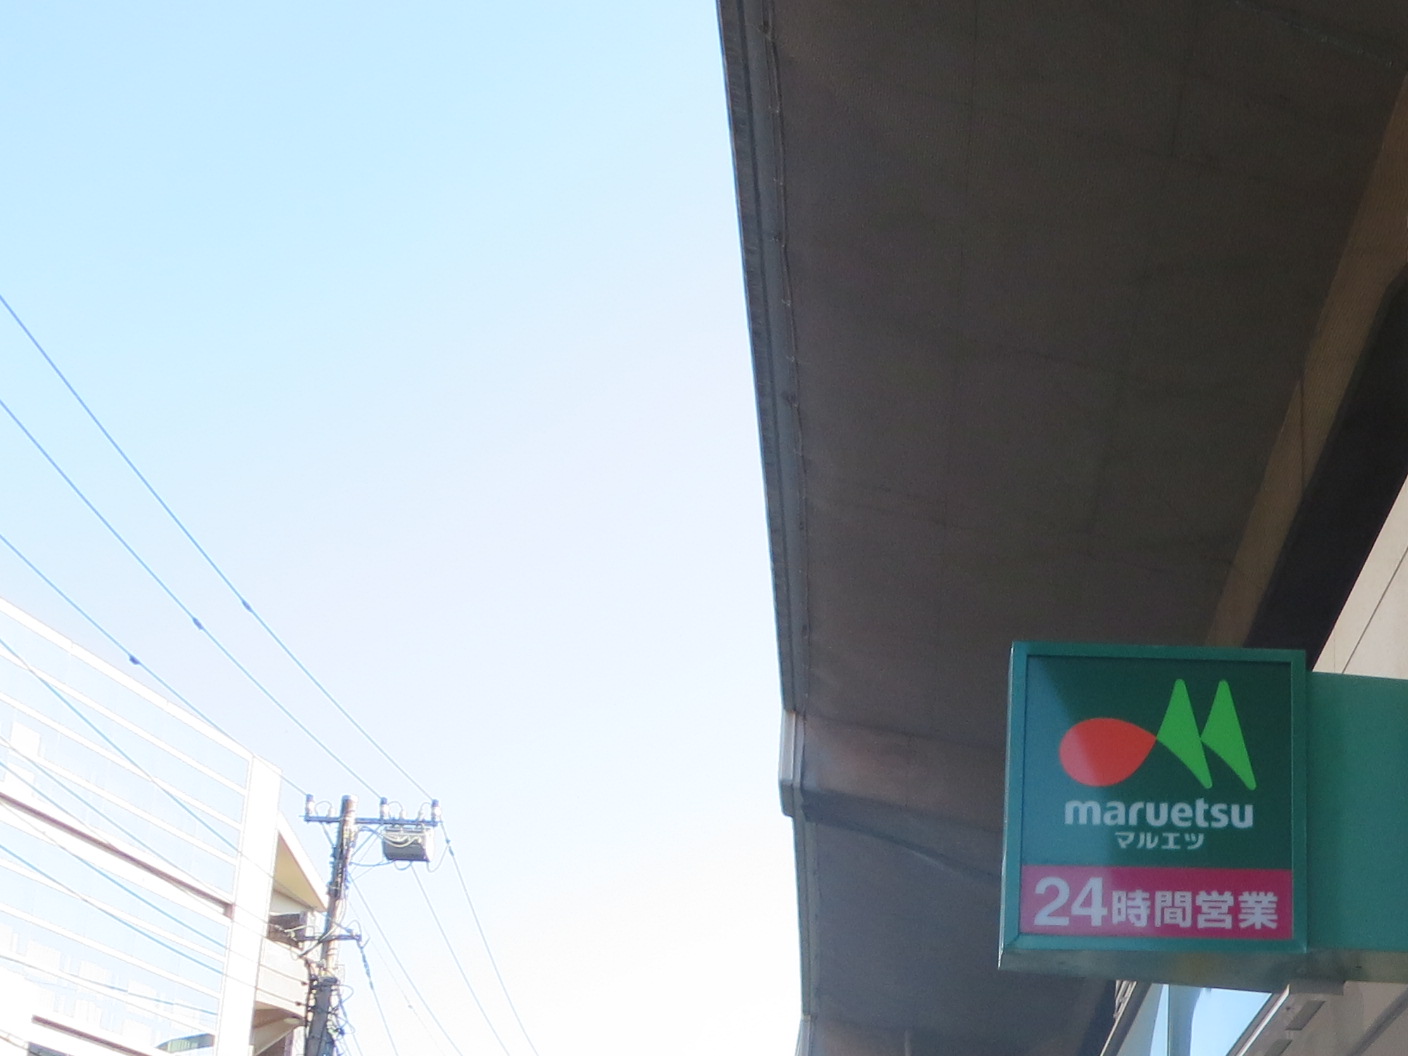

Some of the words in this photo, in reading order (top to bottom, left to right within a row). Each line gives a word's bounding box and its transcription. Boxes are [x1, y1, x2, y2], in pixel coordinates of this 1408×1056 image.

[1064, 798, 1254, 829] maruetsu
[1115, 831, 1206, 851] マルエツ
[1034, 877, 1279, 930] 24時間営業
